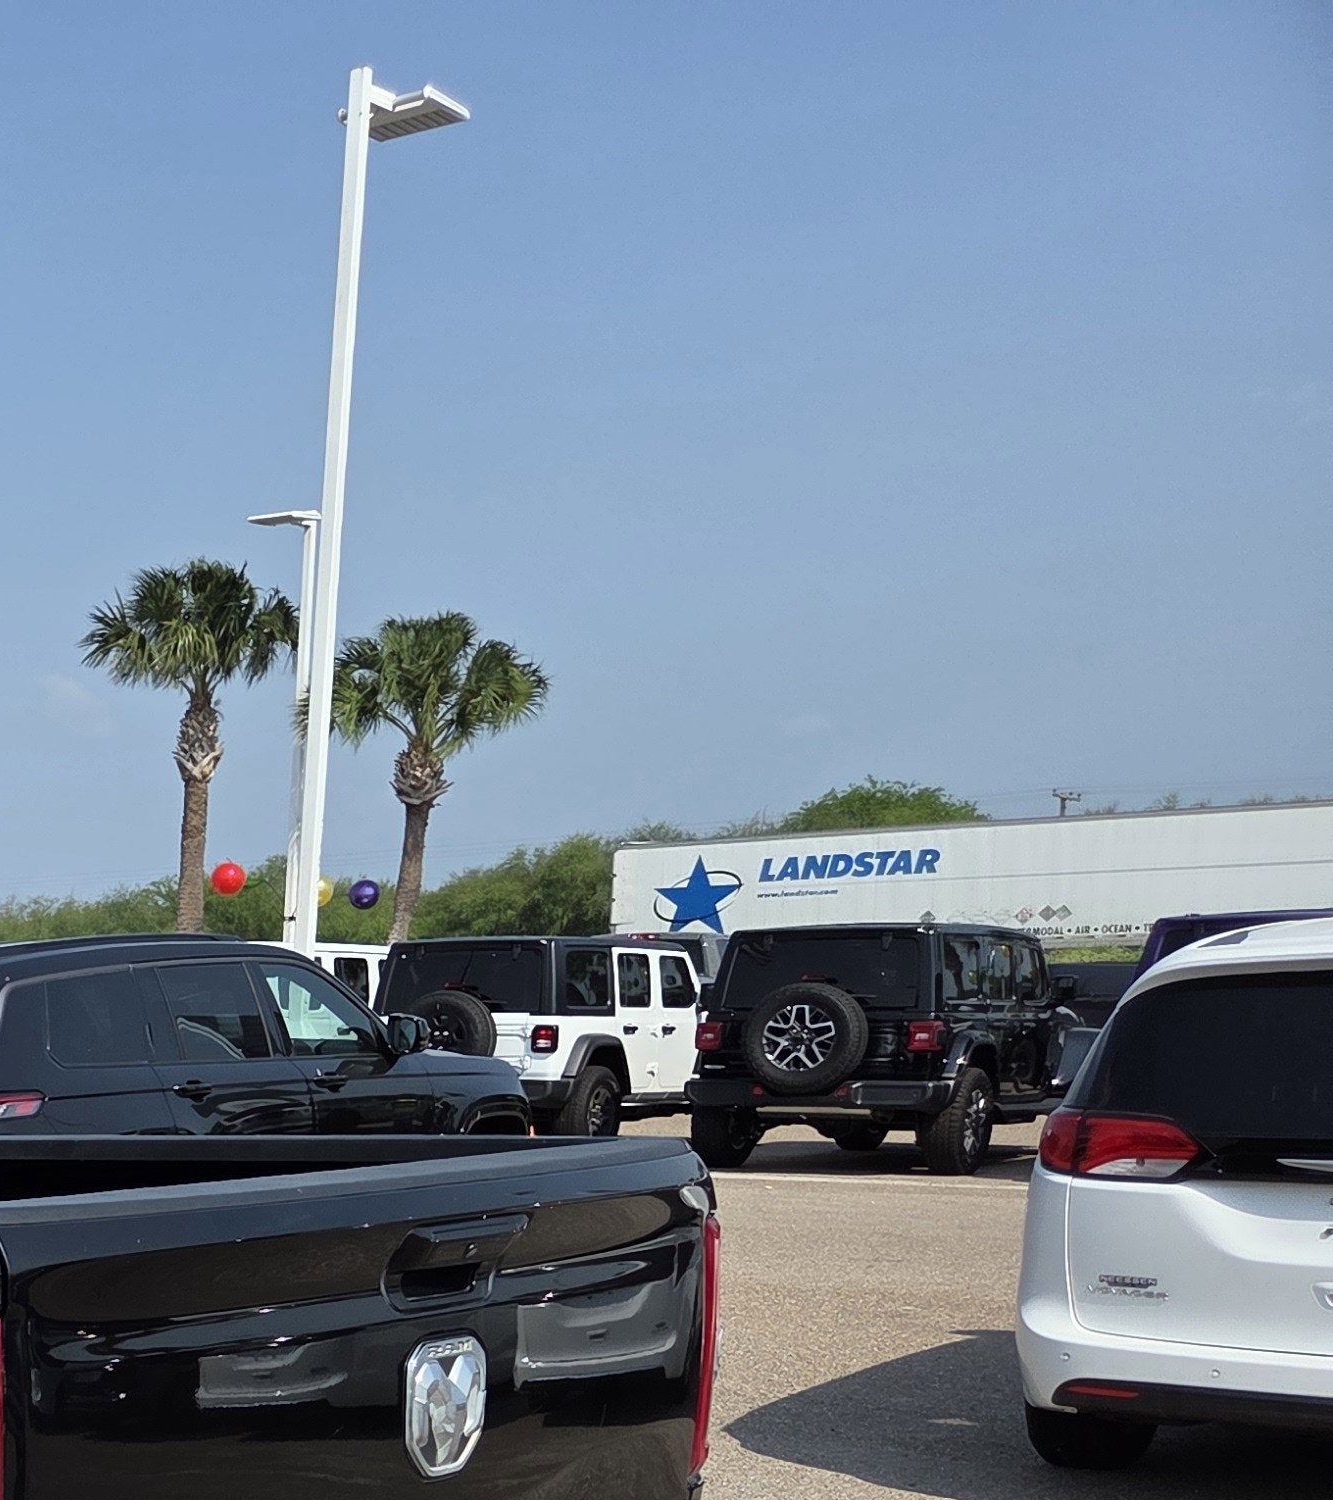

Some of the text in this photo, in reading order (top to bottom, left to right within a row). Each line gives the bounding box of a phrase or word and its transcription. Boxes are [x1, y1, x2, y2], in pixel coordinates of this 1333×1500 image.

[758, 848, 941, 883] LANDSTAR
[757, 888, 838, 899] www.landstar.com
[1075, 925, 1090, 934] AIR
[1101, 924, 1132, 934] OCEAN
